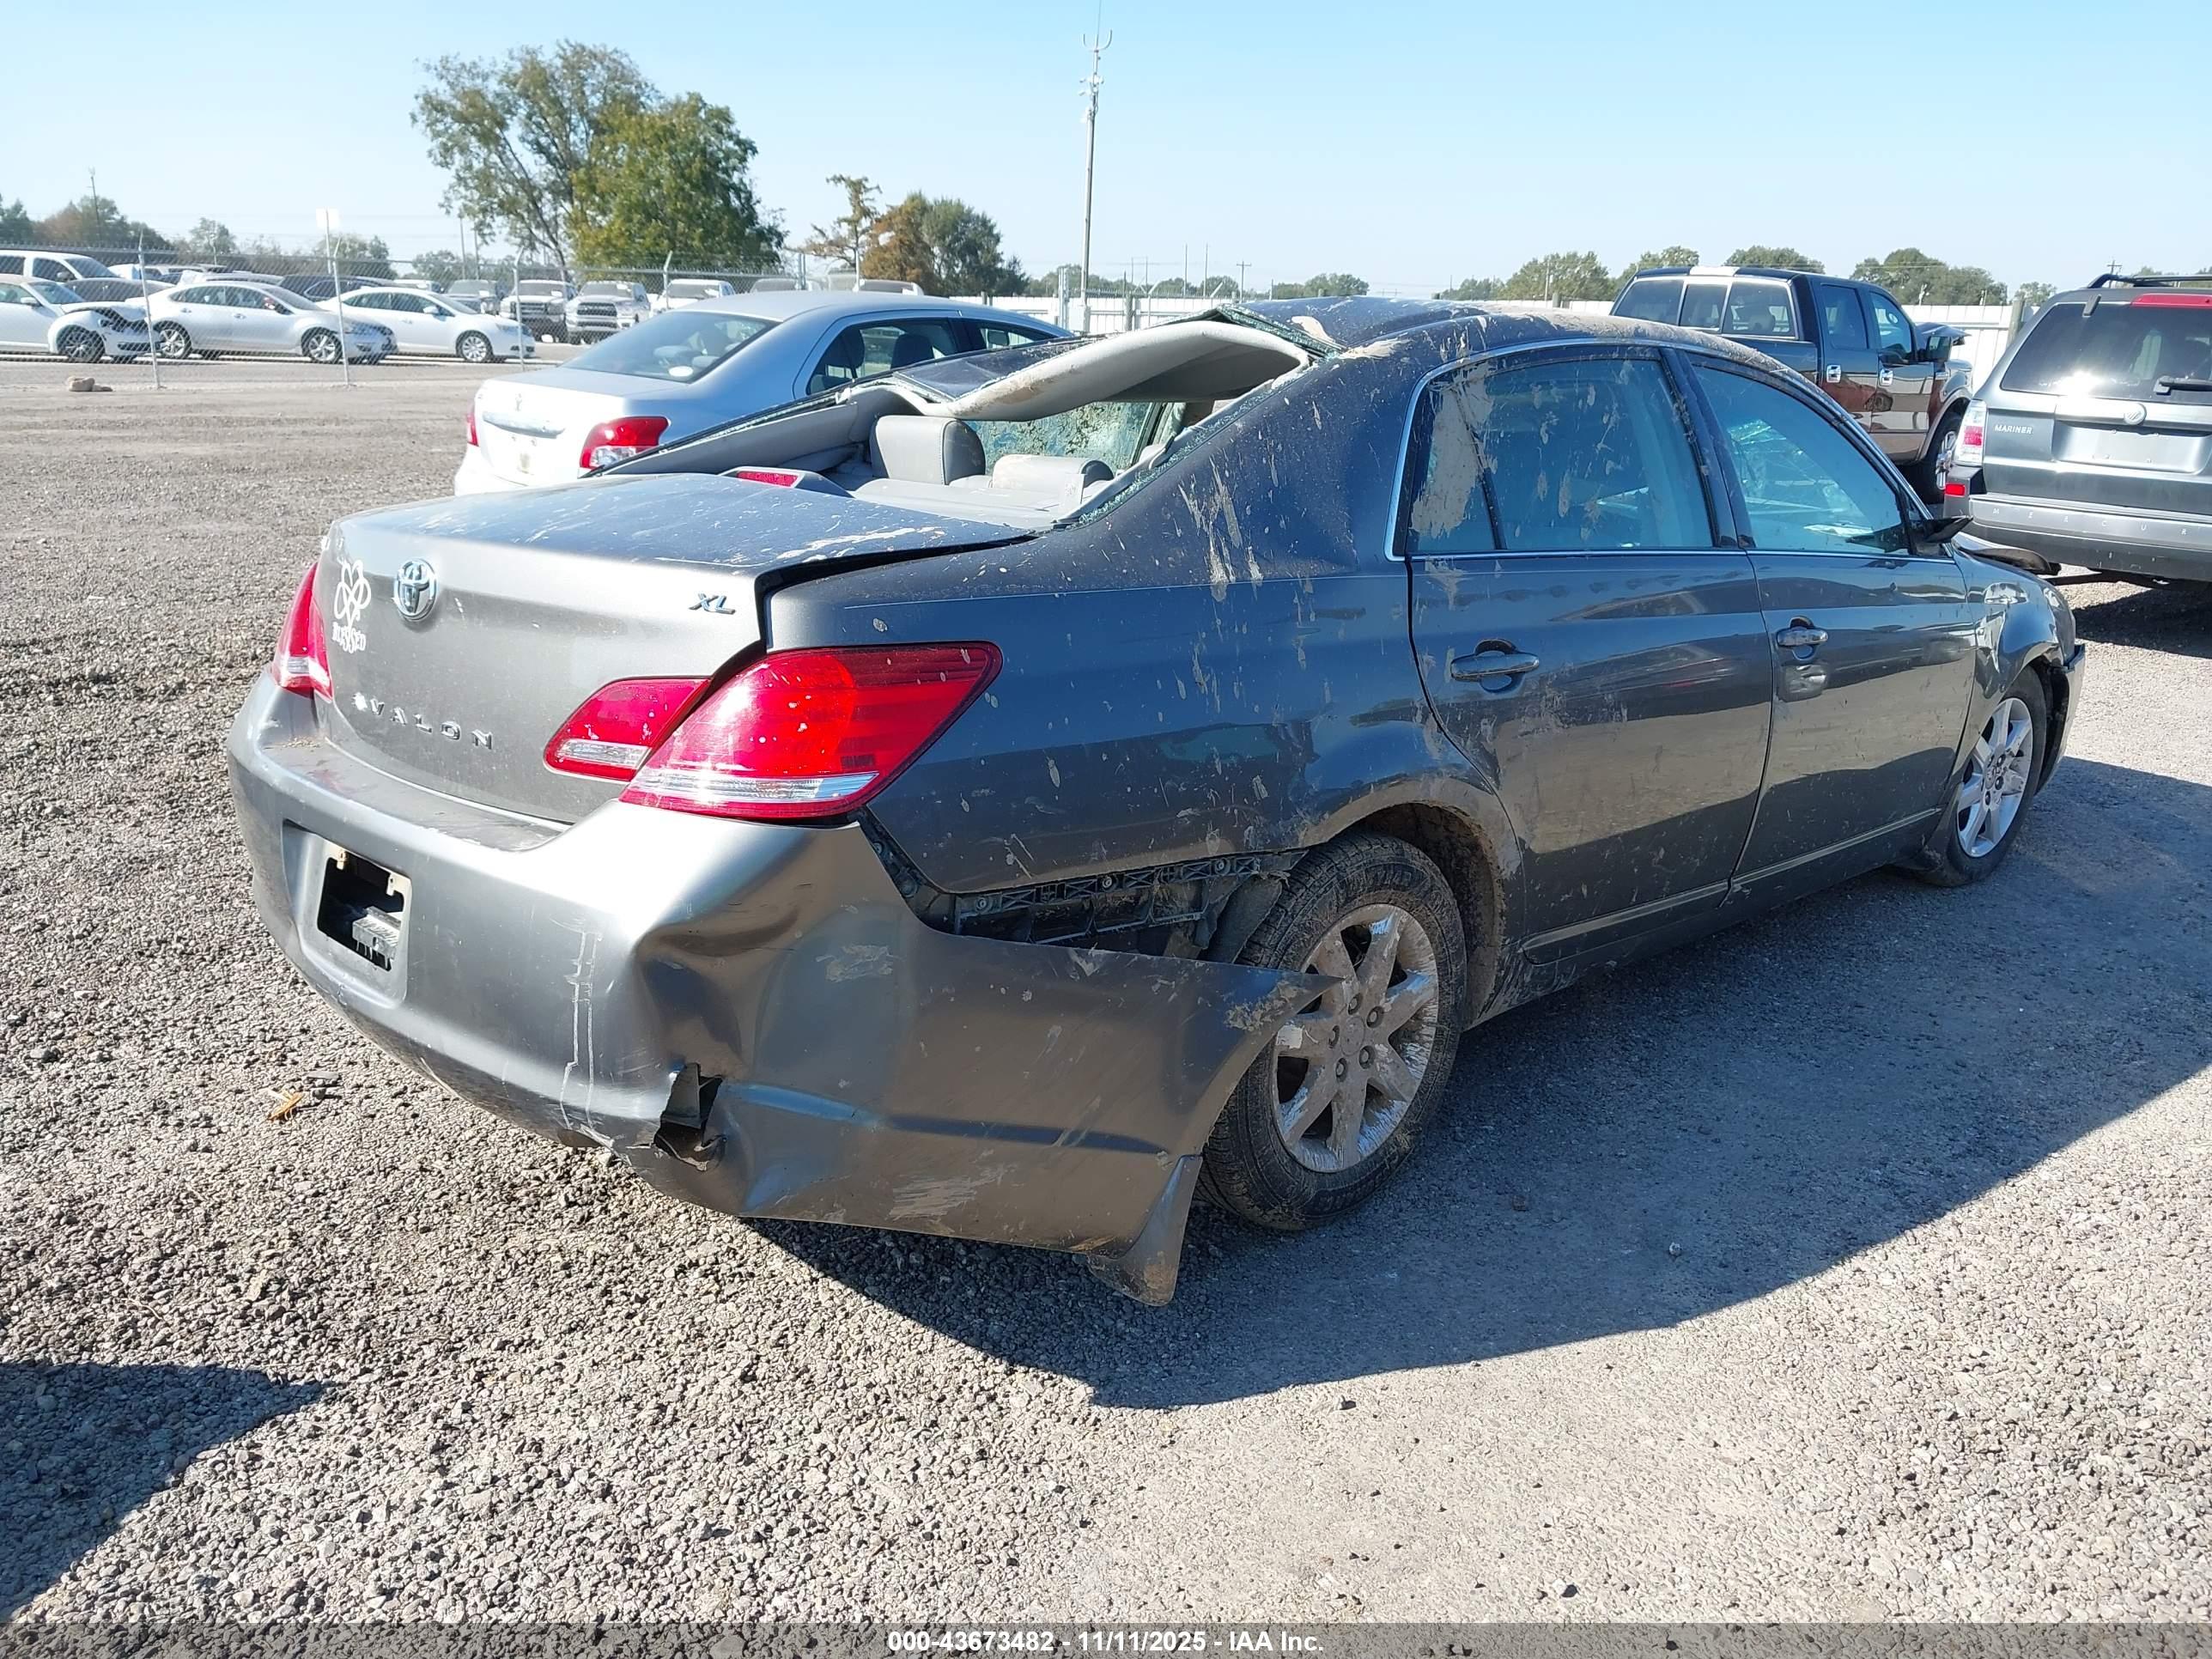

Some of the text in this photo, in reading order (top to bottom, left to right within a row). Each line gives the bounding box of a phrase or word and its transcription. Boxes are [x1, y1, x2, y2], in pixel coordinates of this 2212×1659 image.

[1994, 424, 2033, 434] MARINER
[1992, 507, 2187, 536] MERCUR
[689, 592, 736, 615] XL
